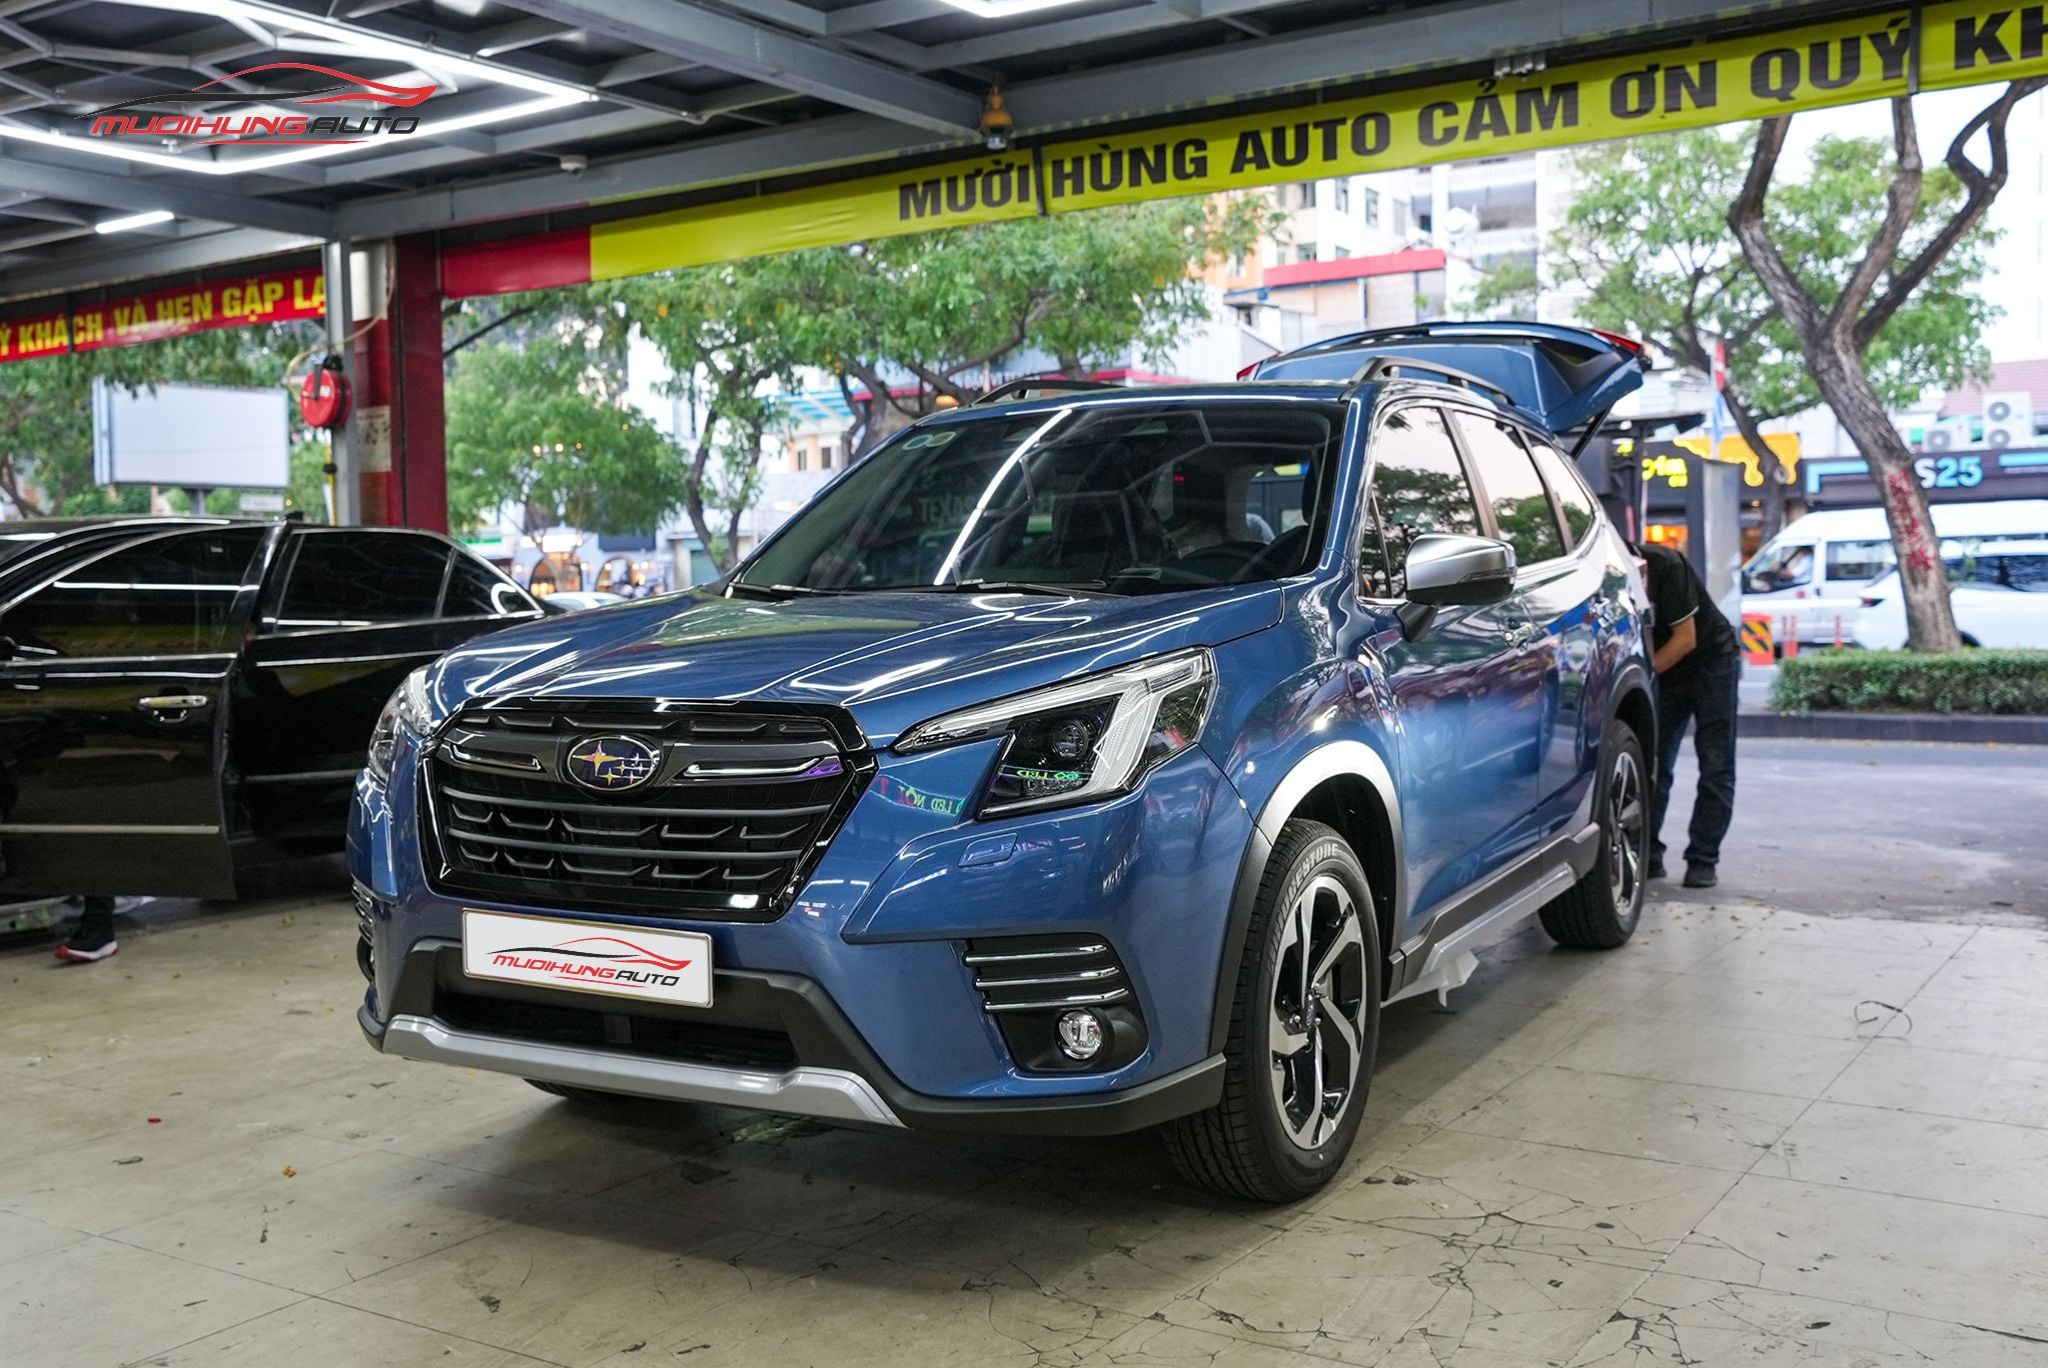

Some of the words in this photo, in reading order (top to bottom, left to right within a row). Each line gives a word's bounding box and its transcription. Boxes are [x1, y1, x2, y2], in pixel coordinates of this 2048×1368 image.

[900, 160, 1029, 221] MƯỜI
[1052, 138, 1207, 197] HÙNG
[1231, 112, 1390, 174] AUTO
[1417, 79, 1580, 147] CẢM
[1610, 60, 1717, 119] ƠN
[1751, 17, 1910, 102] QUÝ
[19, 313, 103, 354] KHÁCH
[114, 299, 150, 337] VÀ
[156, 290, 213, 333] HẸN
[222, 279, 284, 322] GẶP
